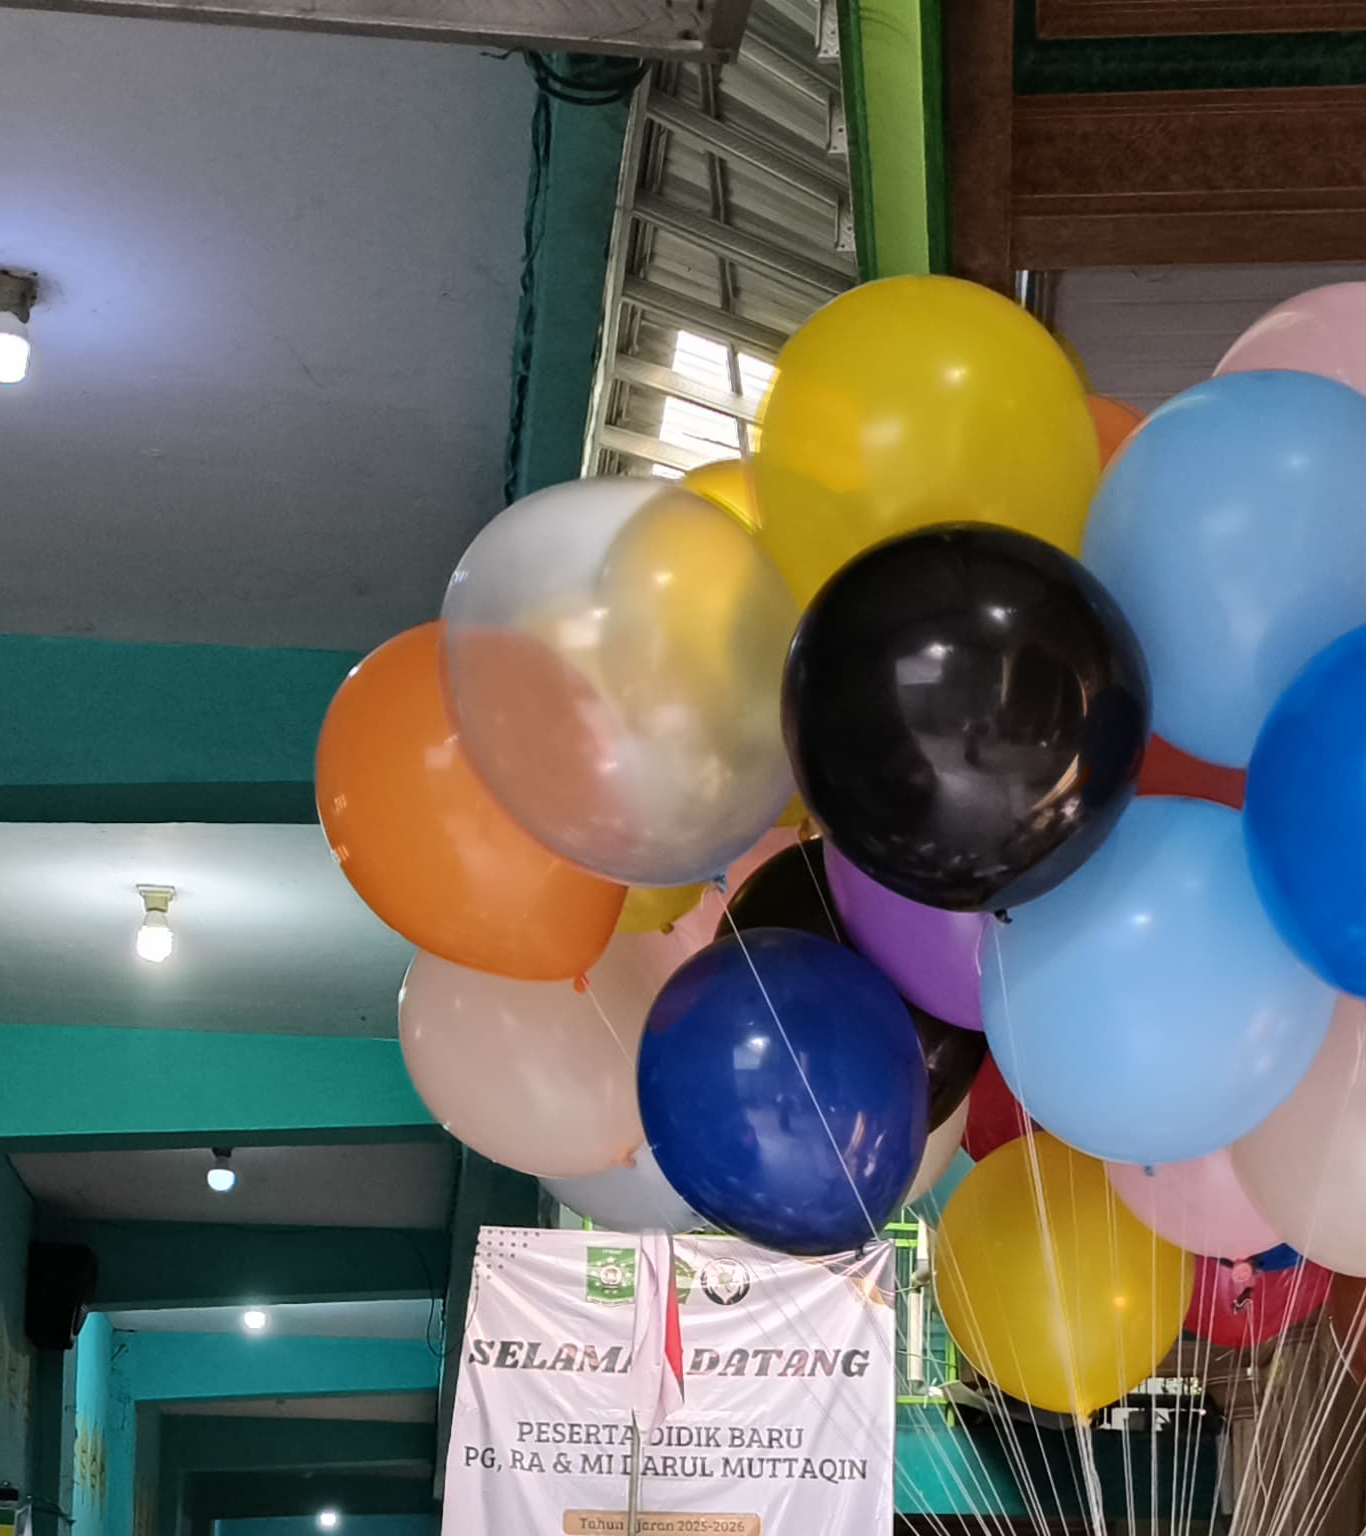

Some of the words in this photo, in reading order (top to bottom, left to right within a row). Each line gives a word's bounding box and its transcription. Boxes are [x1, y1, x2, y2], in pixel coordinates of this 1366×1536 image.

[468, 1339, 633, 1373] SELAM
[686, 1348, 870, 1378] DATANG
[517, 1421, 637, 1446] PESERTA
[728, 1427, 804, 1449] BARU
[464, 1445, 502, 1472] PG,
[509, 1449, 546, 1473] RA
[552, 1452, 572, 1474] &
[579, 1453, 614, 1475] MI
[721, 1457, 868, 1484] MUTTAQIN
[579, 1517, 624, 1531] Tahun
[634, 1518, 675, 1534] jaran
[678, 1519, 745, 1533] 2025-2026
